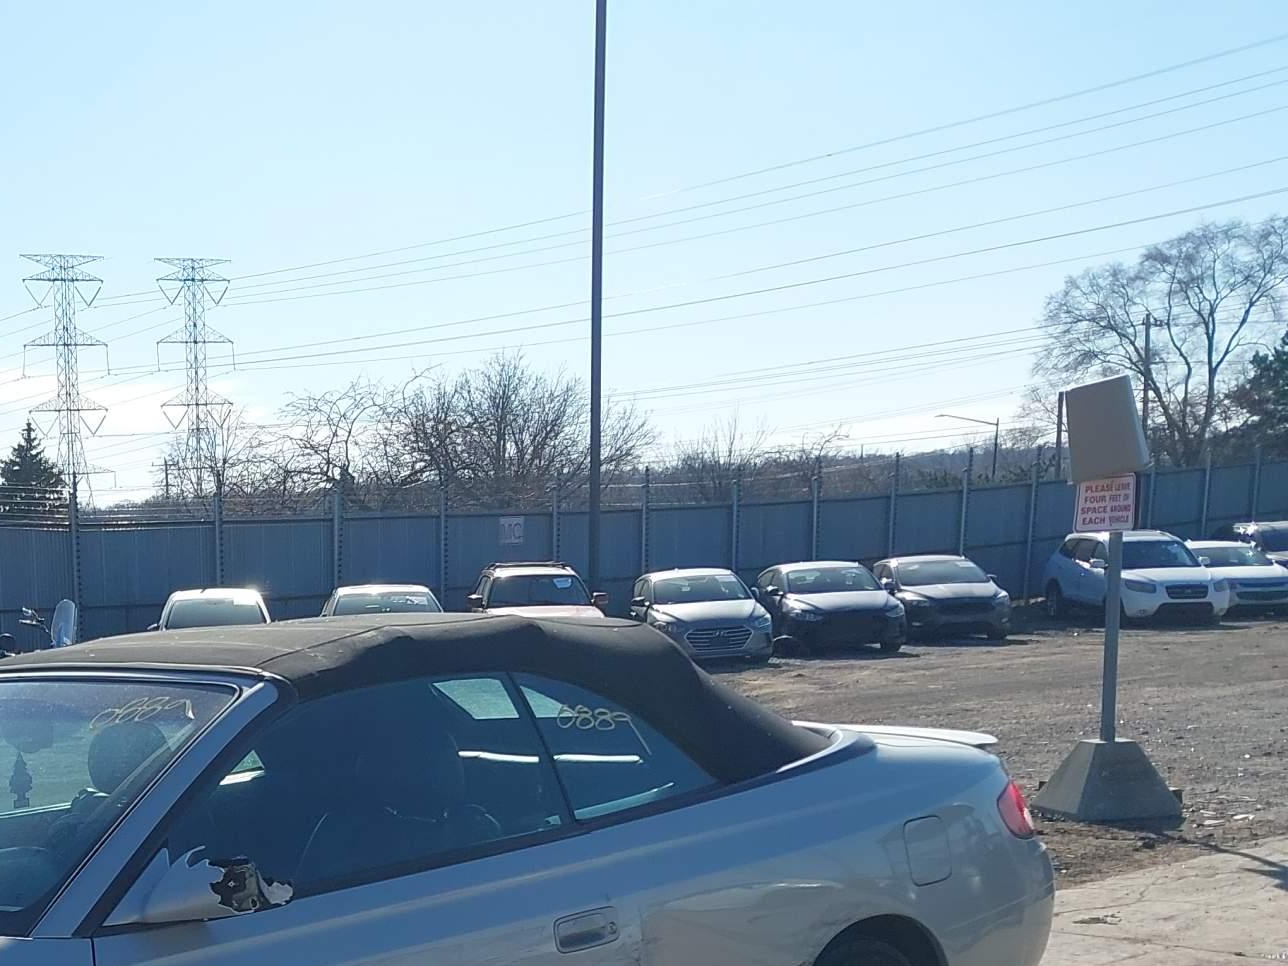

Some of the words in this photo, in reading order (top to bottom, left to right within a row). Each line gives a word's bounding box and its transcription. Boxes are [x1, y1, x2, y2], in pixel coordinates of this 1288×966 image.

[1085, 483, 1113, 493] PLEASE
[1084, 495, 1107, 504] FOUR
[1081, 505, 1108, 515] SPACE
[1110, 504, 1132, 513] AROUND
[1082, 516, 1106, 526] EACH
